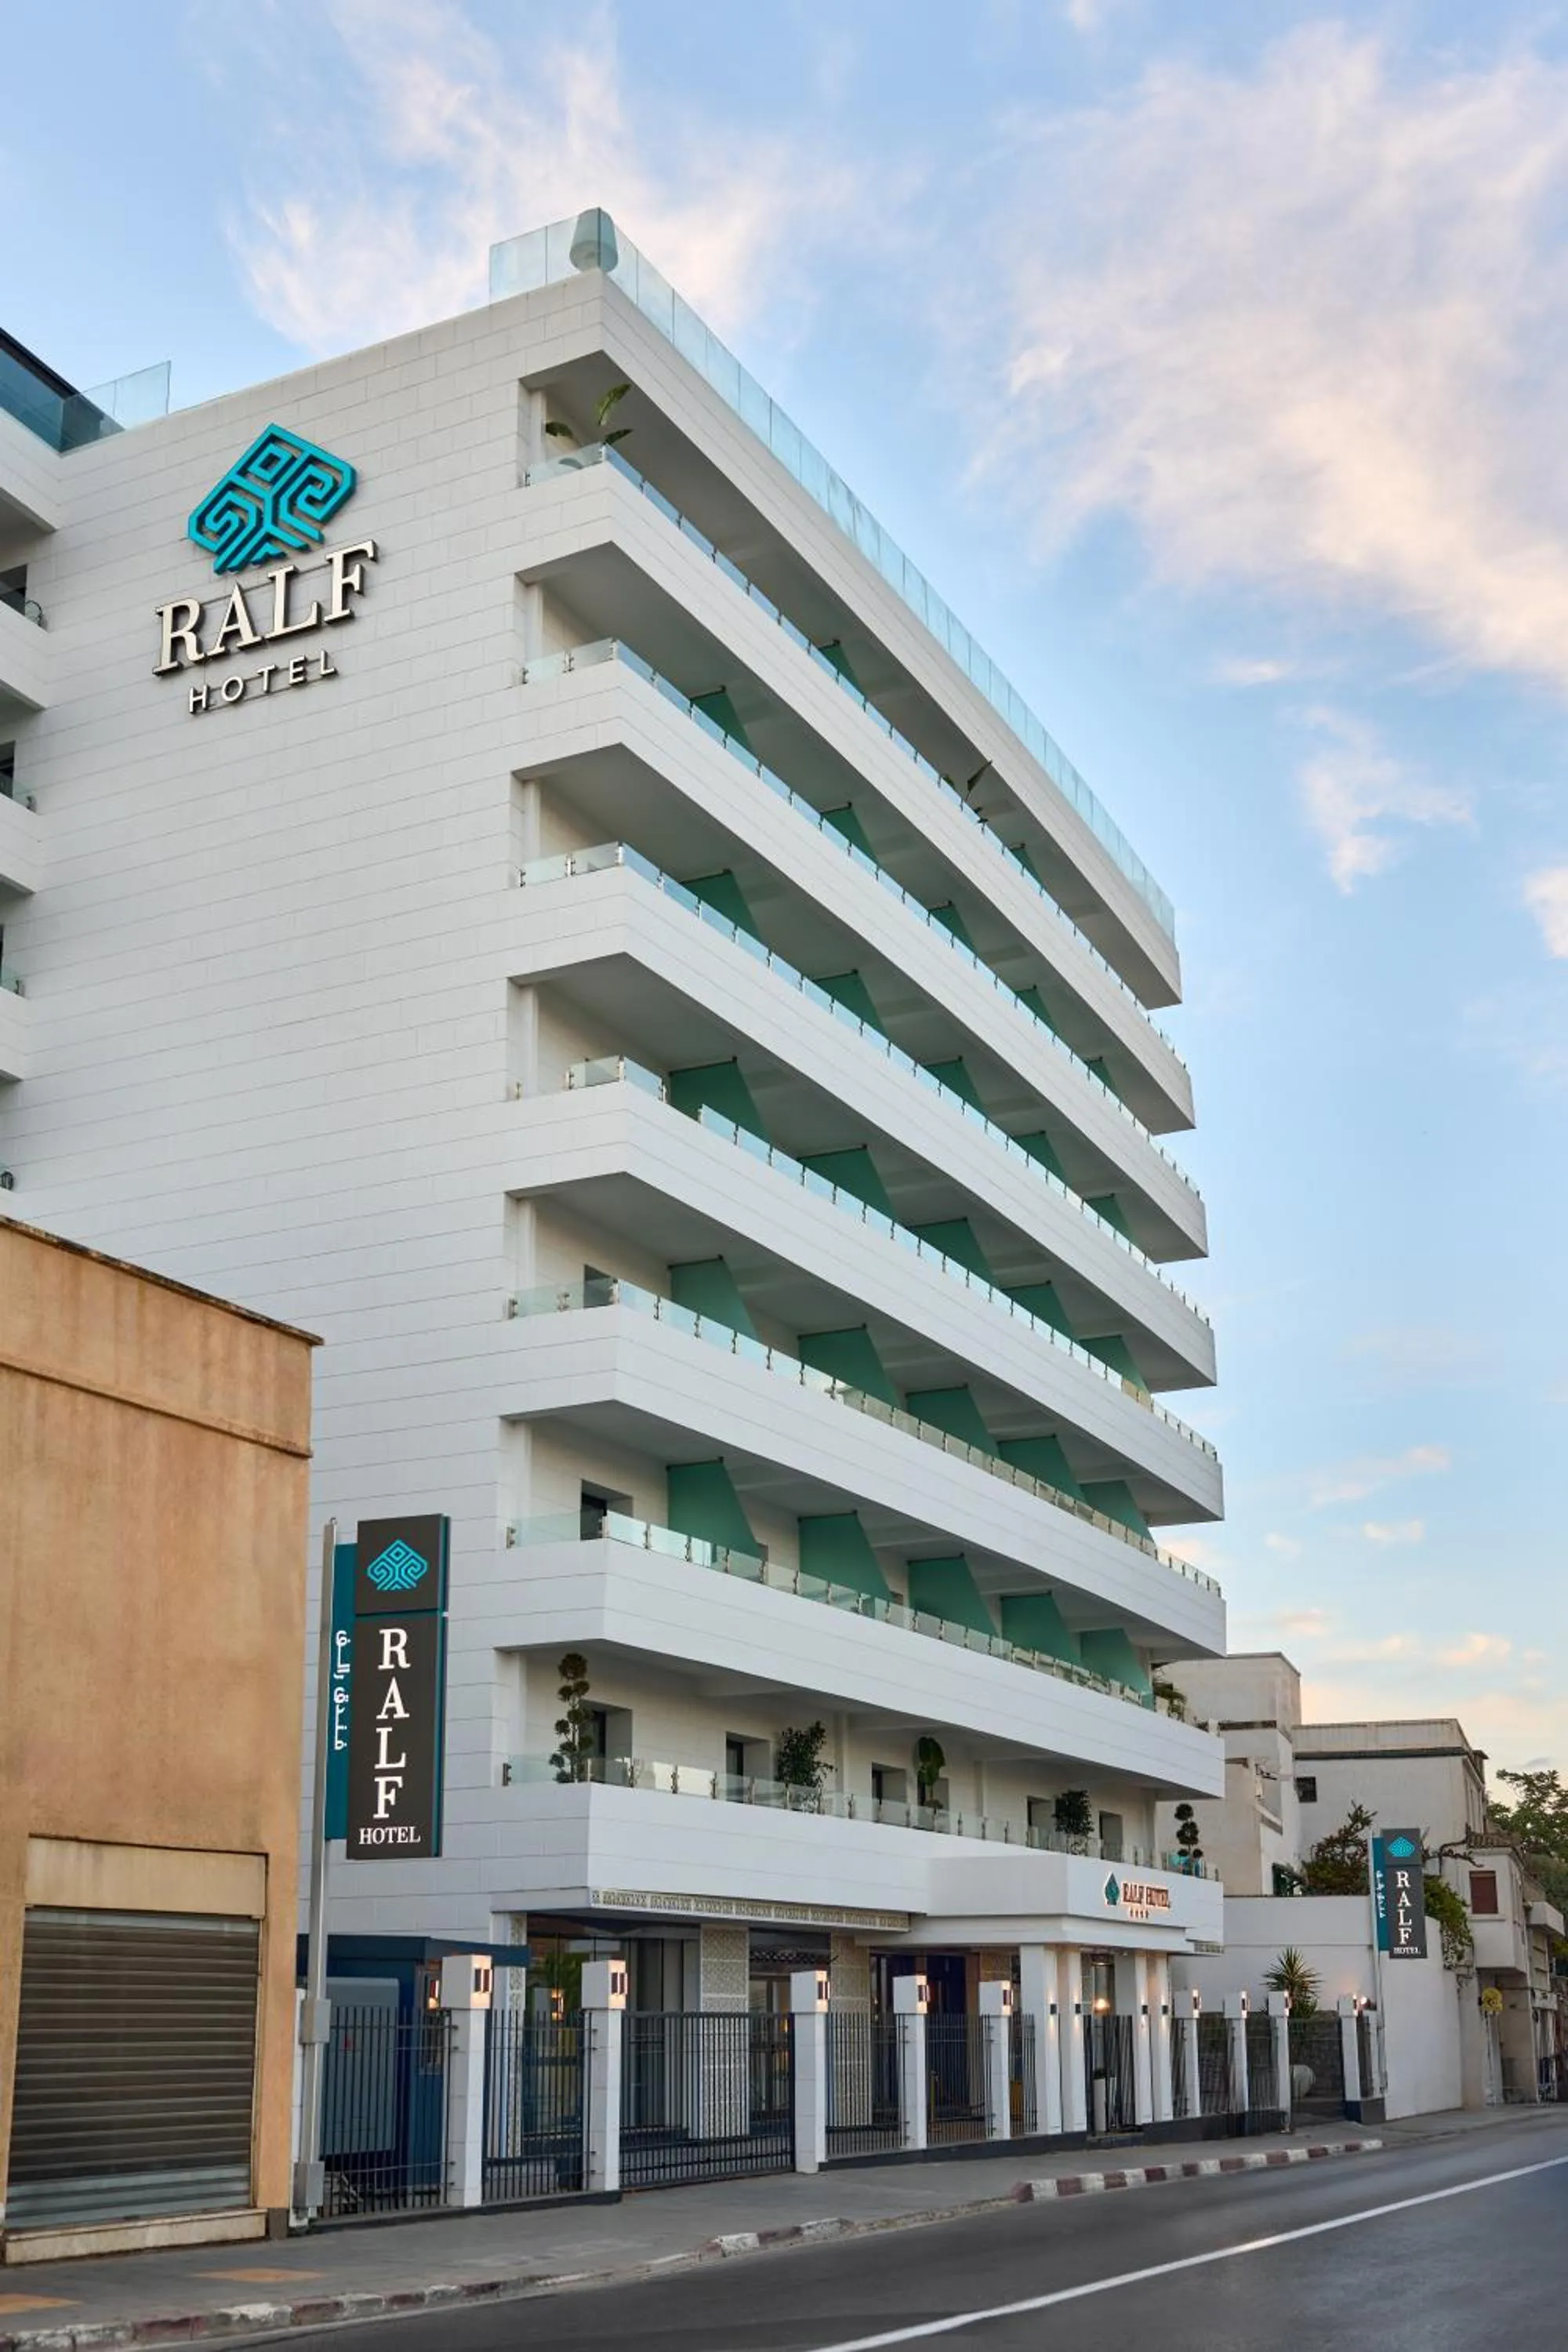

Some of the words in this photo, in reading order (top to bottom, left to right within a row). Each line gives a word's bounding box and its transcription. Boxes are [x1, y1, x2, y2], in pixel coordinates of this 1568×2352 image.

[153, 540, 378, 674] RALF
[189, 650, 337, 713] HOTEL
[373, 1628, 411, 1820] RALF
[358, 1827, 421, 1845] HOTEL
[1396, 1871, 1412, 1945] RALF
